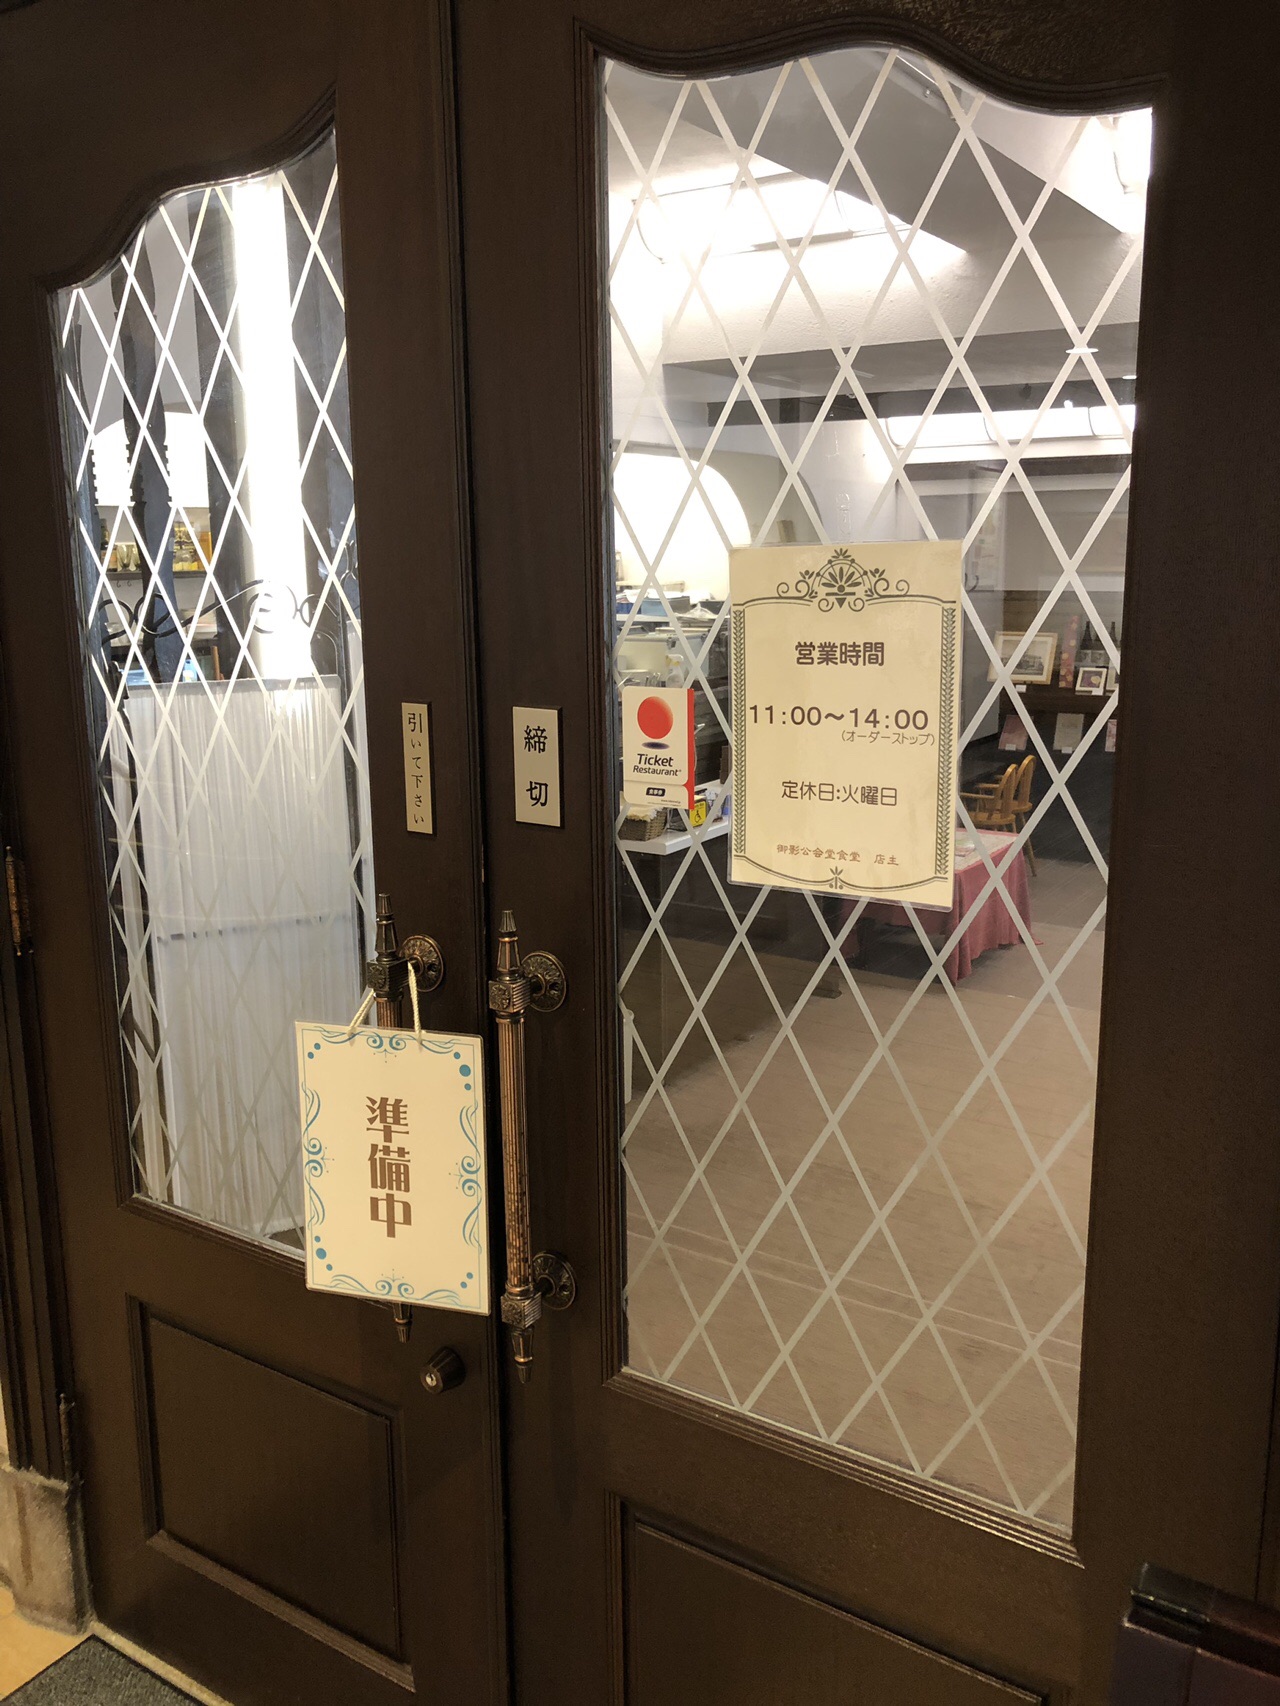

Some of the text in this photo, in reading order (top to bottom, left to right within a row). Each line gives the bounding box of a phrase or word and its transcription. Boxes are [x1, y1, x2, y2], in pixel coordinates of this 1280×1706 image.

[795, 641, 885, 666] 営業時間
[841, 729, 936, 747] (オーダーストップ)
[407, 712, 425, 824] 引いて下さい
[637, 753, 674, 767] Ticket
[781, 780, 898, 807] 定休日:火曜日
[776, 843, 899, 866] 御影公会堂食堂 店主
[365, 1095, 412, 1239] 準備中
